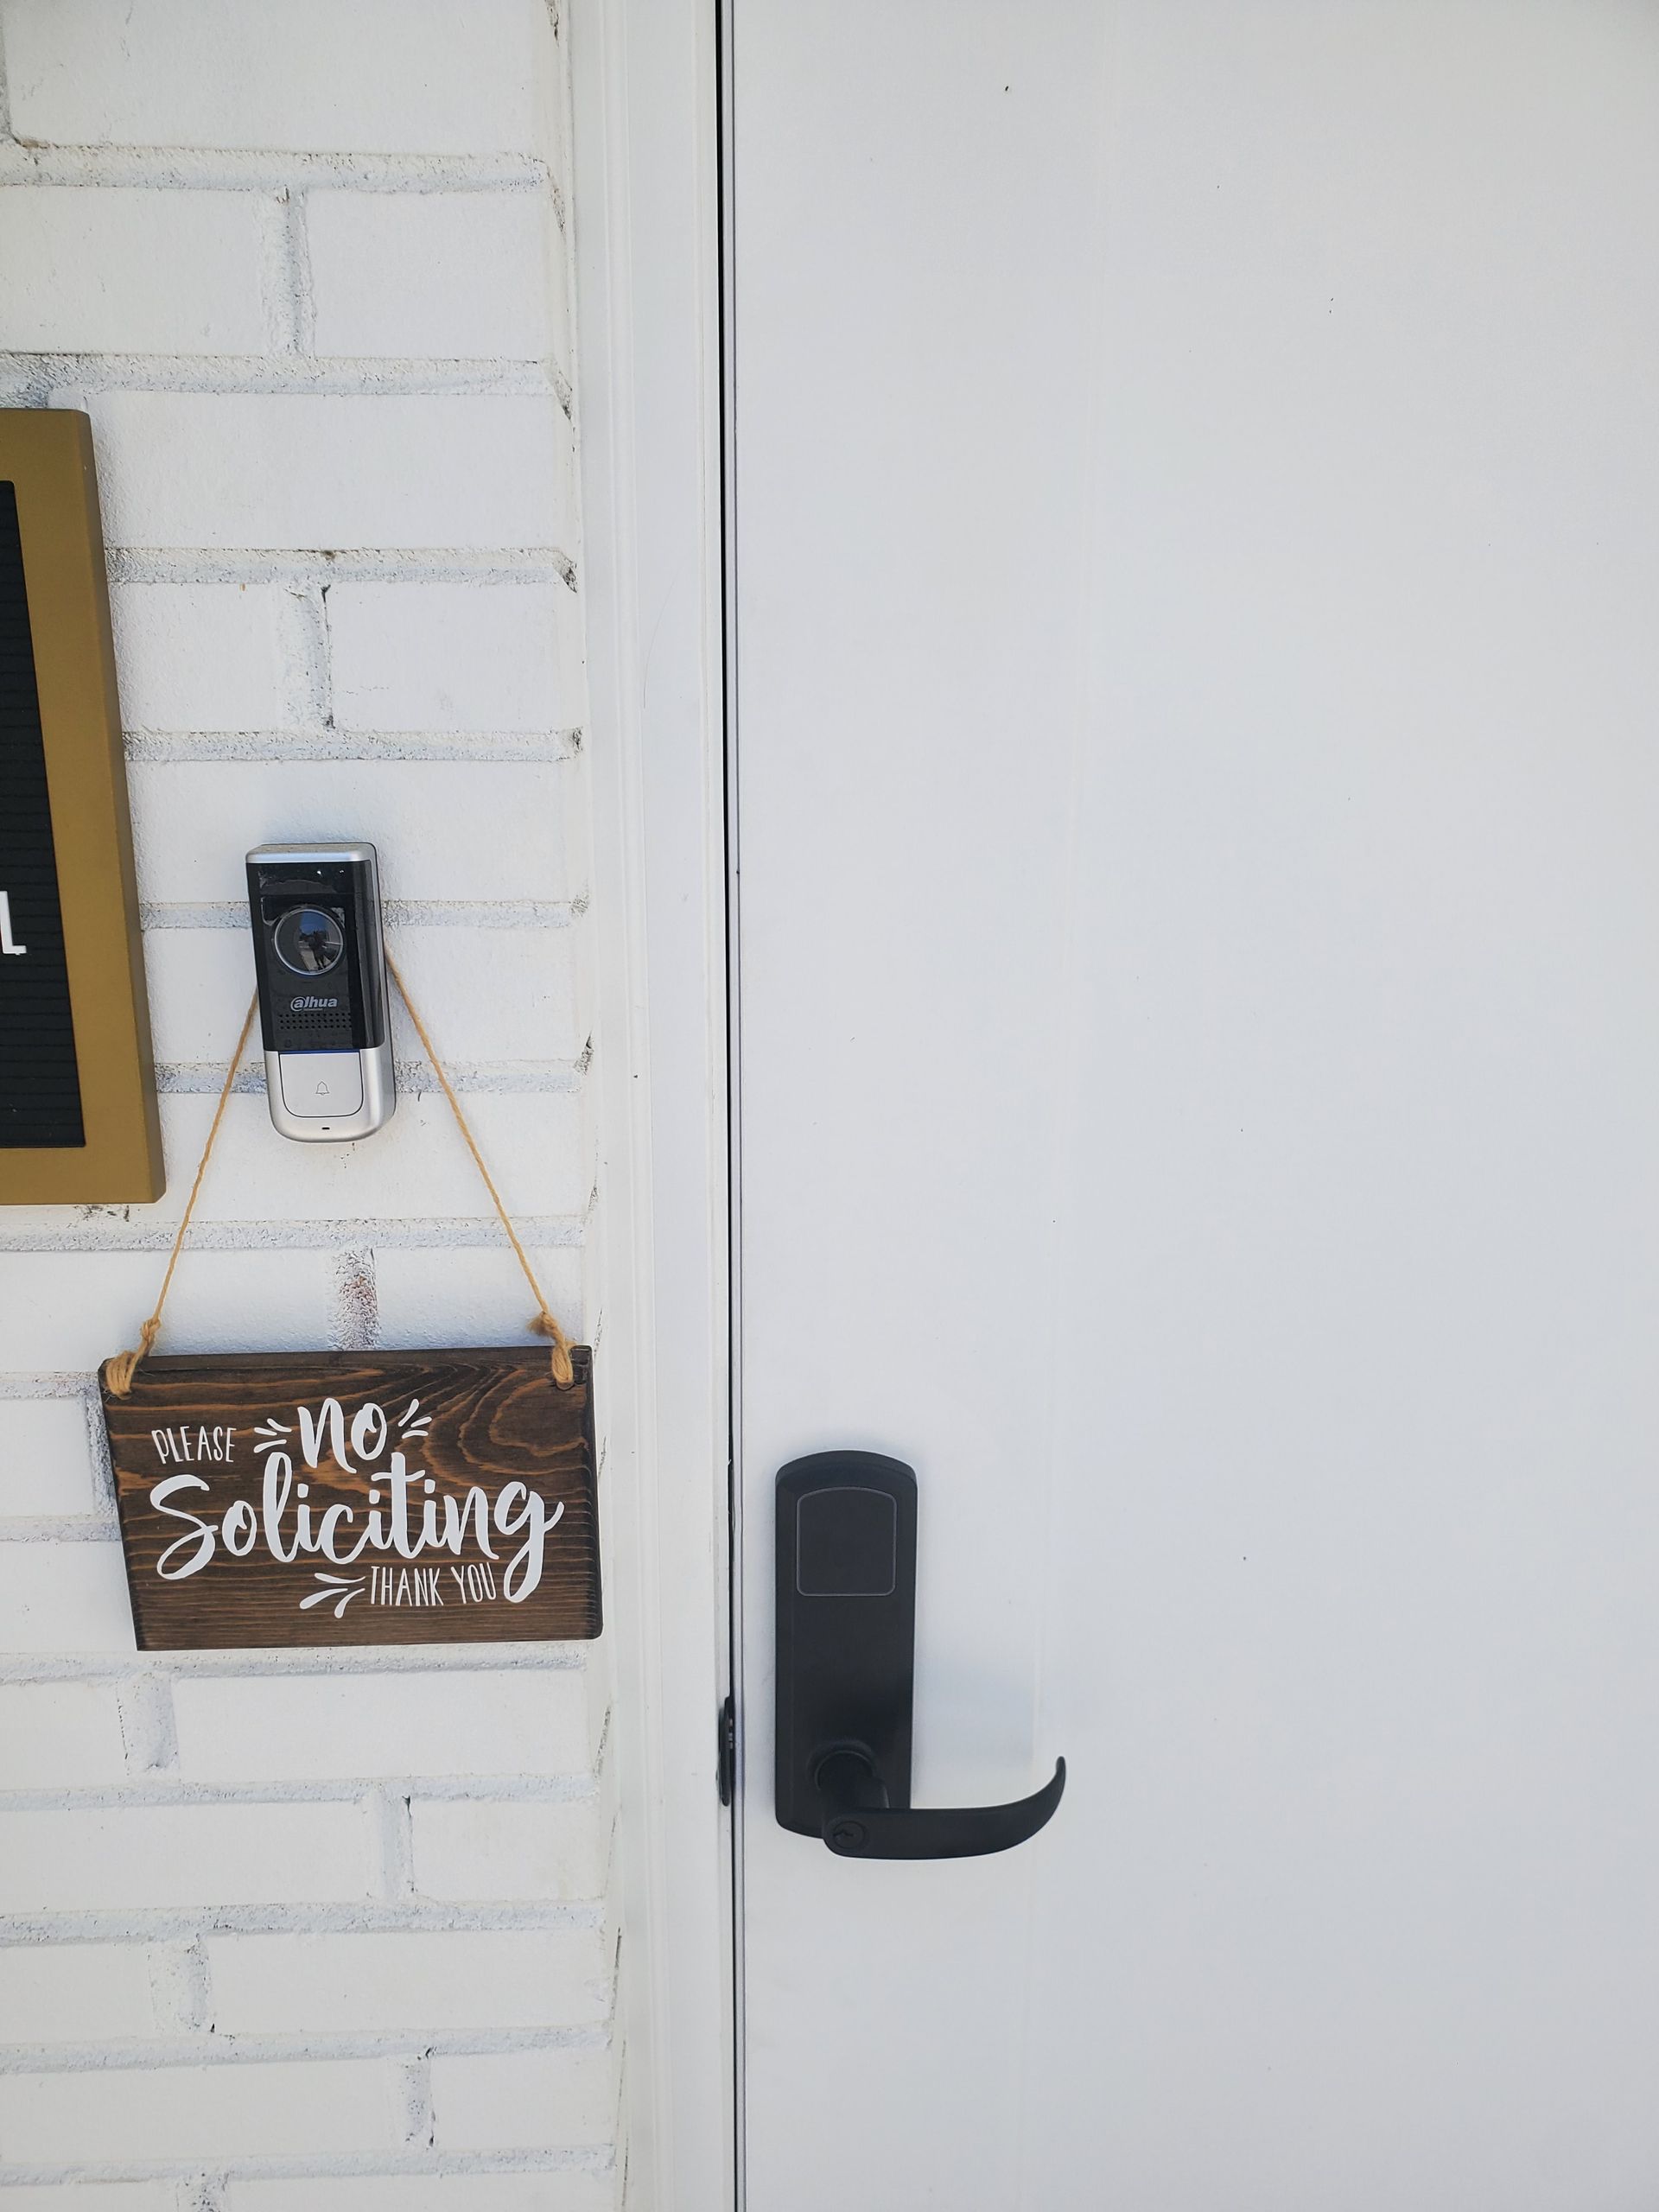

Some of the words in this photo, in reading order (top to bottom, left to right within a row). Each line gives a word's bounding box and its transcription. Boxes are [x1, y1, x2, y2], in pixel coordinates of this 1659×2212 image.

[0, 890, 27, 956] L
[151, 1426, 238, 1465] PLEASE
[149, 1452, 565, 1604] Soliciting
[371, 1565, 444, 1607] THANK
[450, 1561, 497, 1605] YOU
